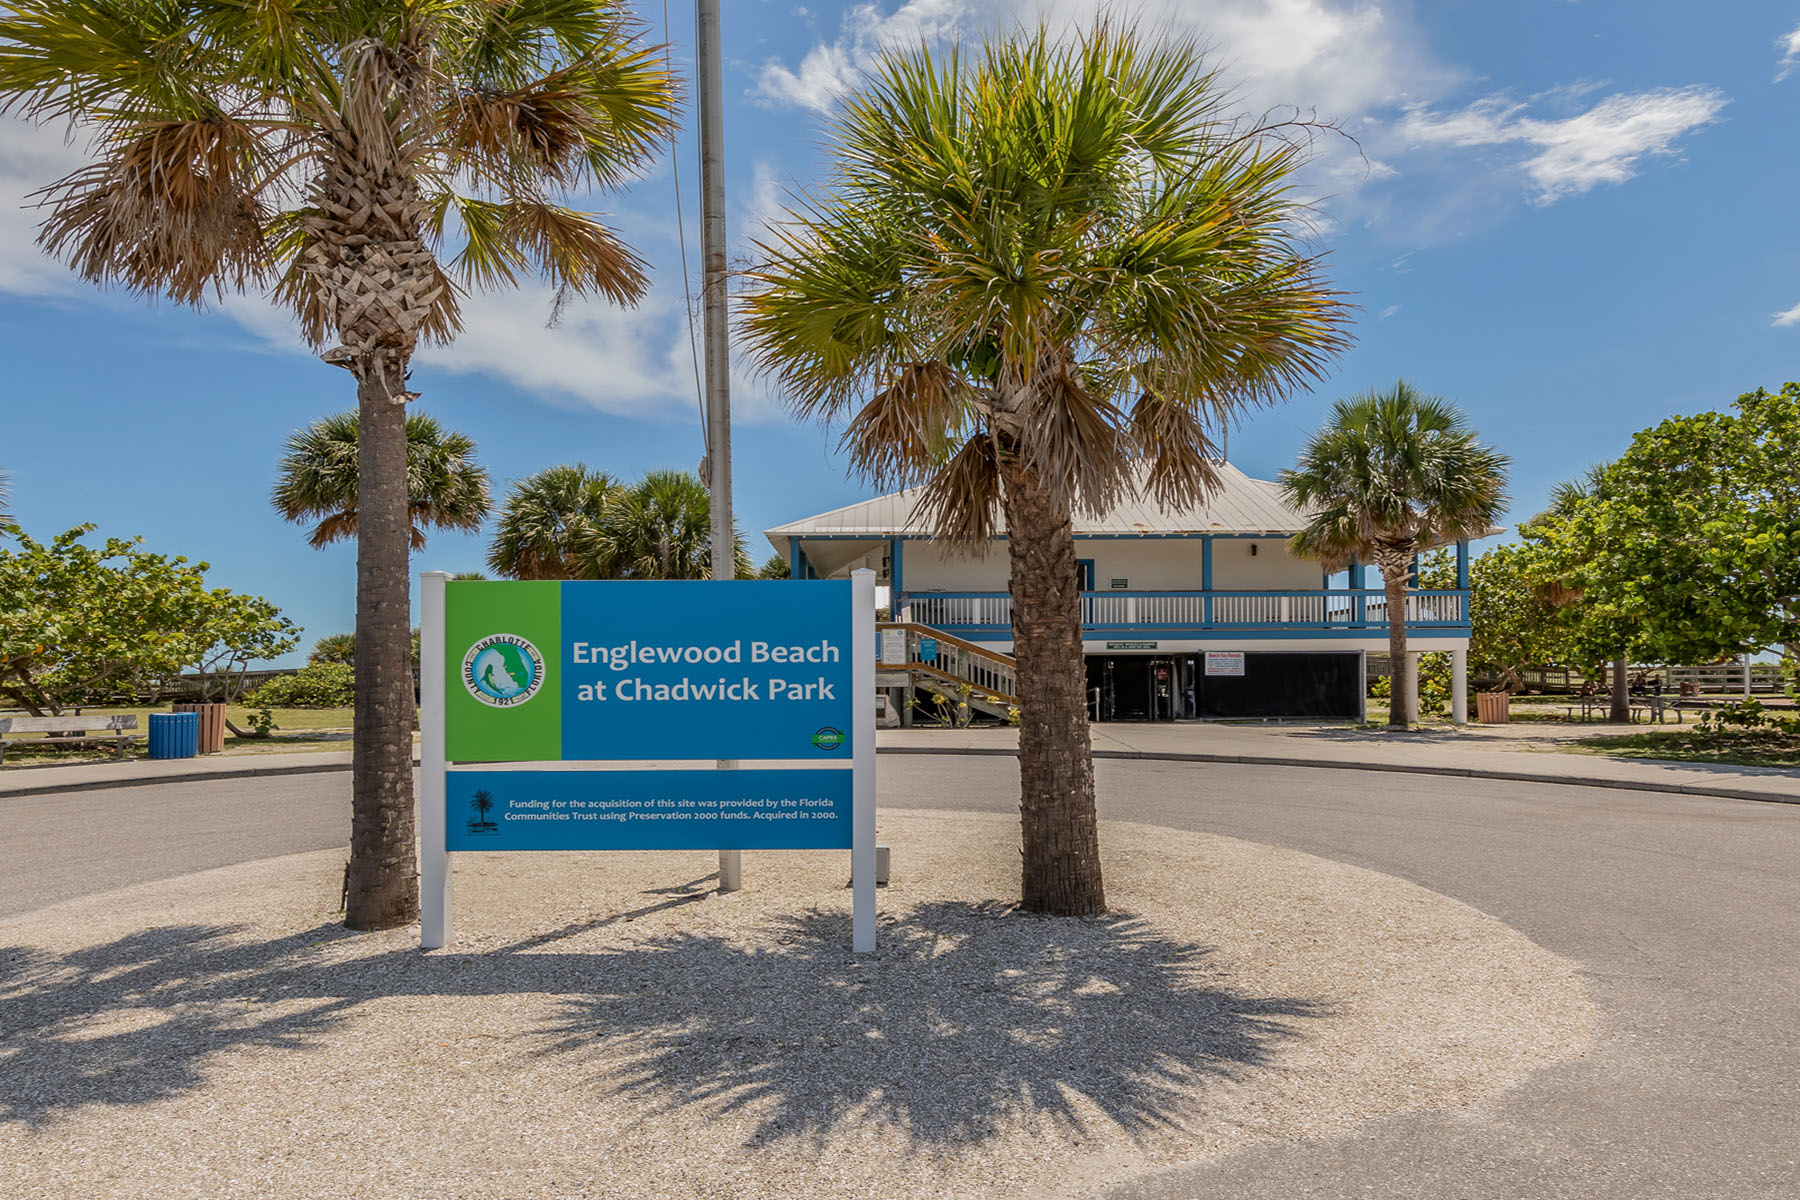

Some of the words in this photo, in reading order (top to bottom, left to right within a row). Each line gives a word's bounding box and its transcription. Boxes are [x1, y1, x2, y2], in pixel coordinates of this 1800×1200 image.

[476, 636, 531, 651] CHARLOTTE
[573, 640, 741, 671] Englewood
[751, 640, 839, 662] Beach
[465, 661, 481, 694] COUNTY
[525, 658, 543, 696] FLORIDA
[577, 680, 606, 701] at
[615, 677, 760, 701] Chadwick
[769, 677, 835, 700] Park
[494, 697, 514, 706] 1921
[509, 799, 549, 810] Funding
[552, 799, 567, 808] for
[569, 799, 586, 808] the
[588, 799, 642, 810] acquisition
[644, 799, 655, 808] of
[657, 799, 676, 808] this
[677, 799, 696, 808] site
[698, 800, 717, 808] was
[719, 799, 764, 809] provided
[766, 799, 778, 809] by
[780, 799, 797, 808] the
[799, 799, 834, 807] Florida
[504, 812, 570, 821] Communities
[572, 812, 598, 820] Trust
[599, 812, 627, 822] using
[628, 811, 692, 820] Preservation
[694, 812, 718, 820] 2000
[720, 811, 751, 820] funds.
[753, 811, 797, 821] Acquired
[799, 811, 809, 819] in
